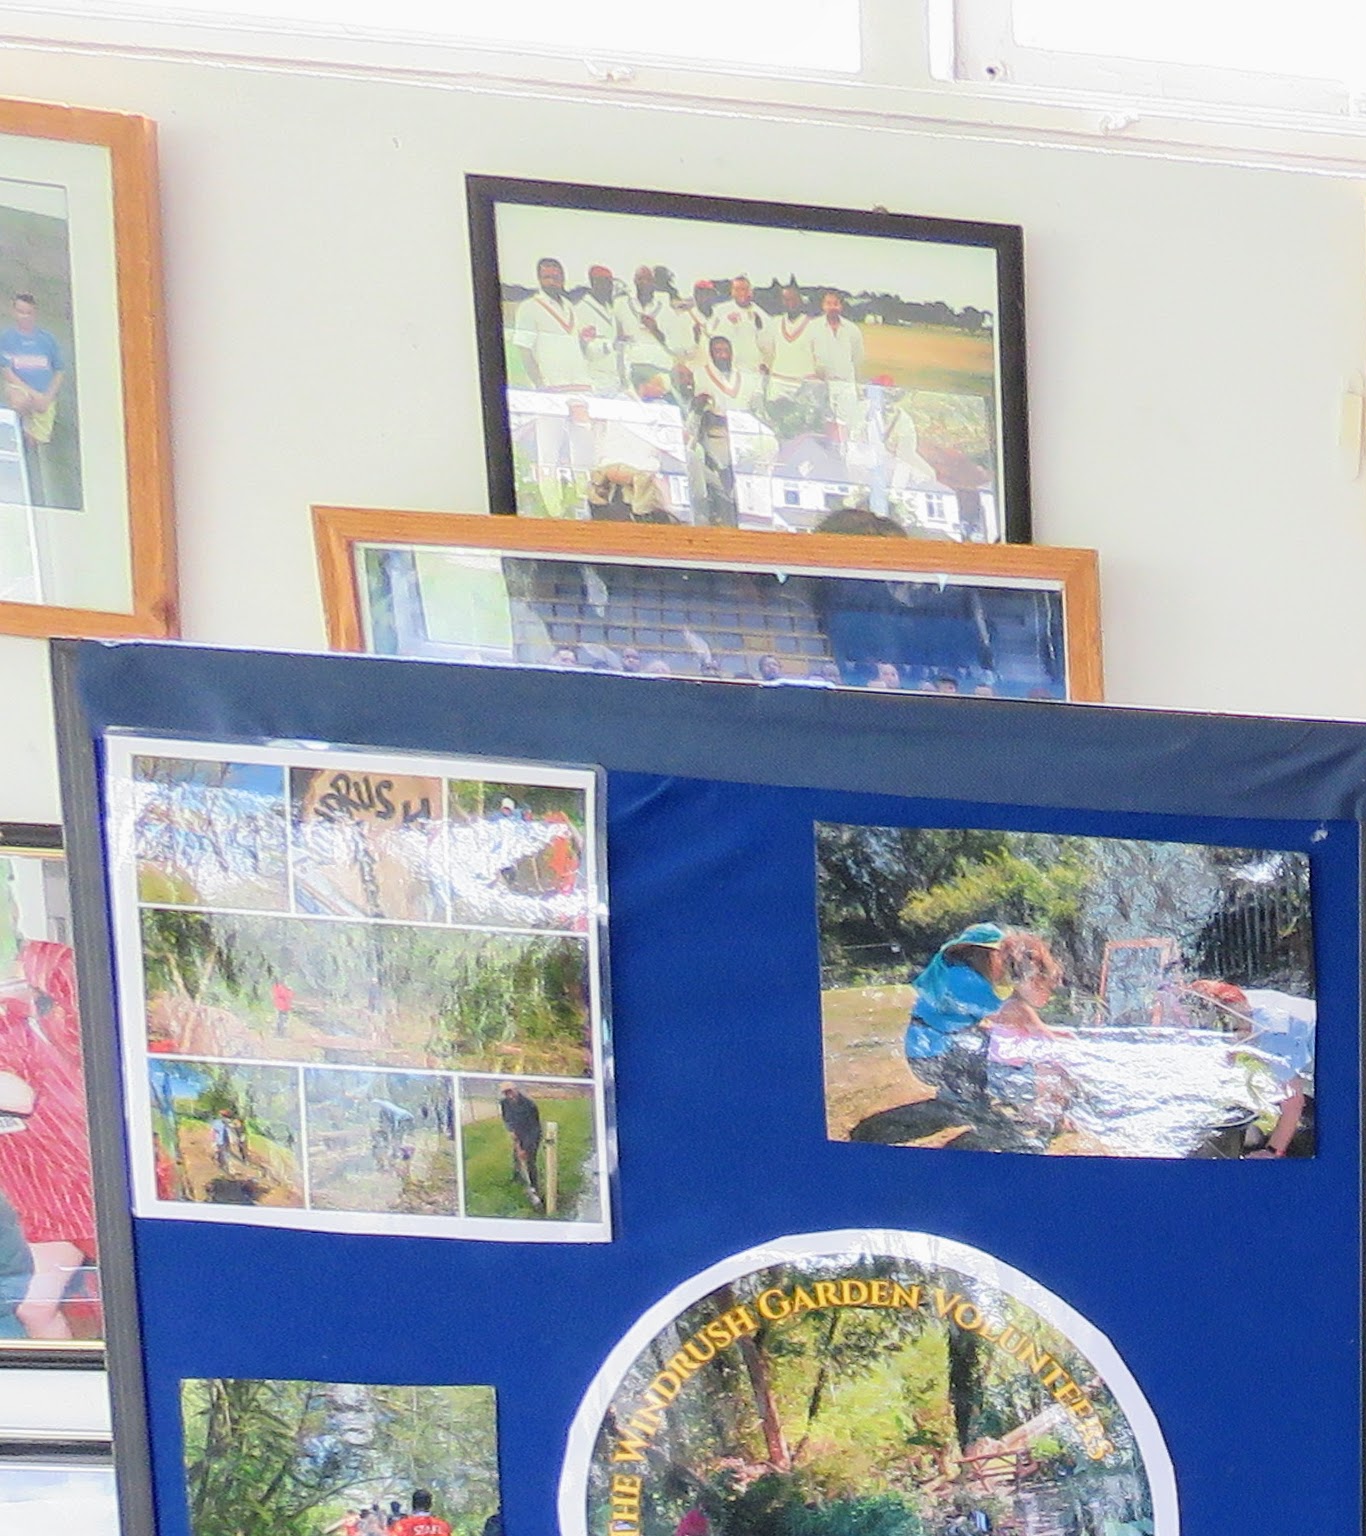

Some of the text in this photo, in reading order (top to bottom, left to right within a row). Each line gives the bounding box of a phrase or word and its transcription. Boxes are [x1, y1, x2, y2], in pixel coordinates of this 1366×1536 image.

[613, 1304, 759, 1463] WINDRUSH
[757, 1277, 922, 1323] GARDEN
[934, 1287, 1114, 1461] VOLUNTEERS
